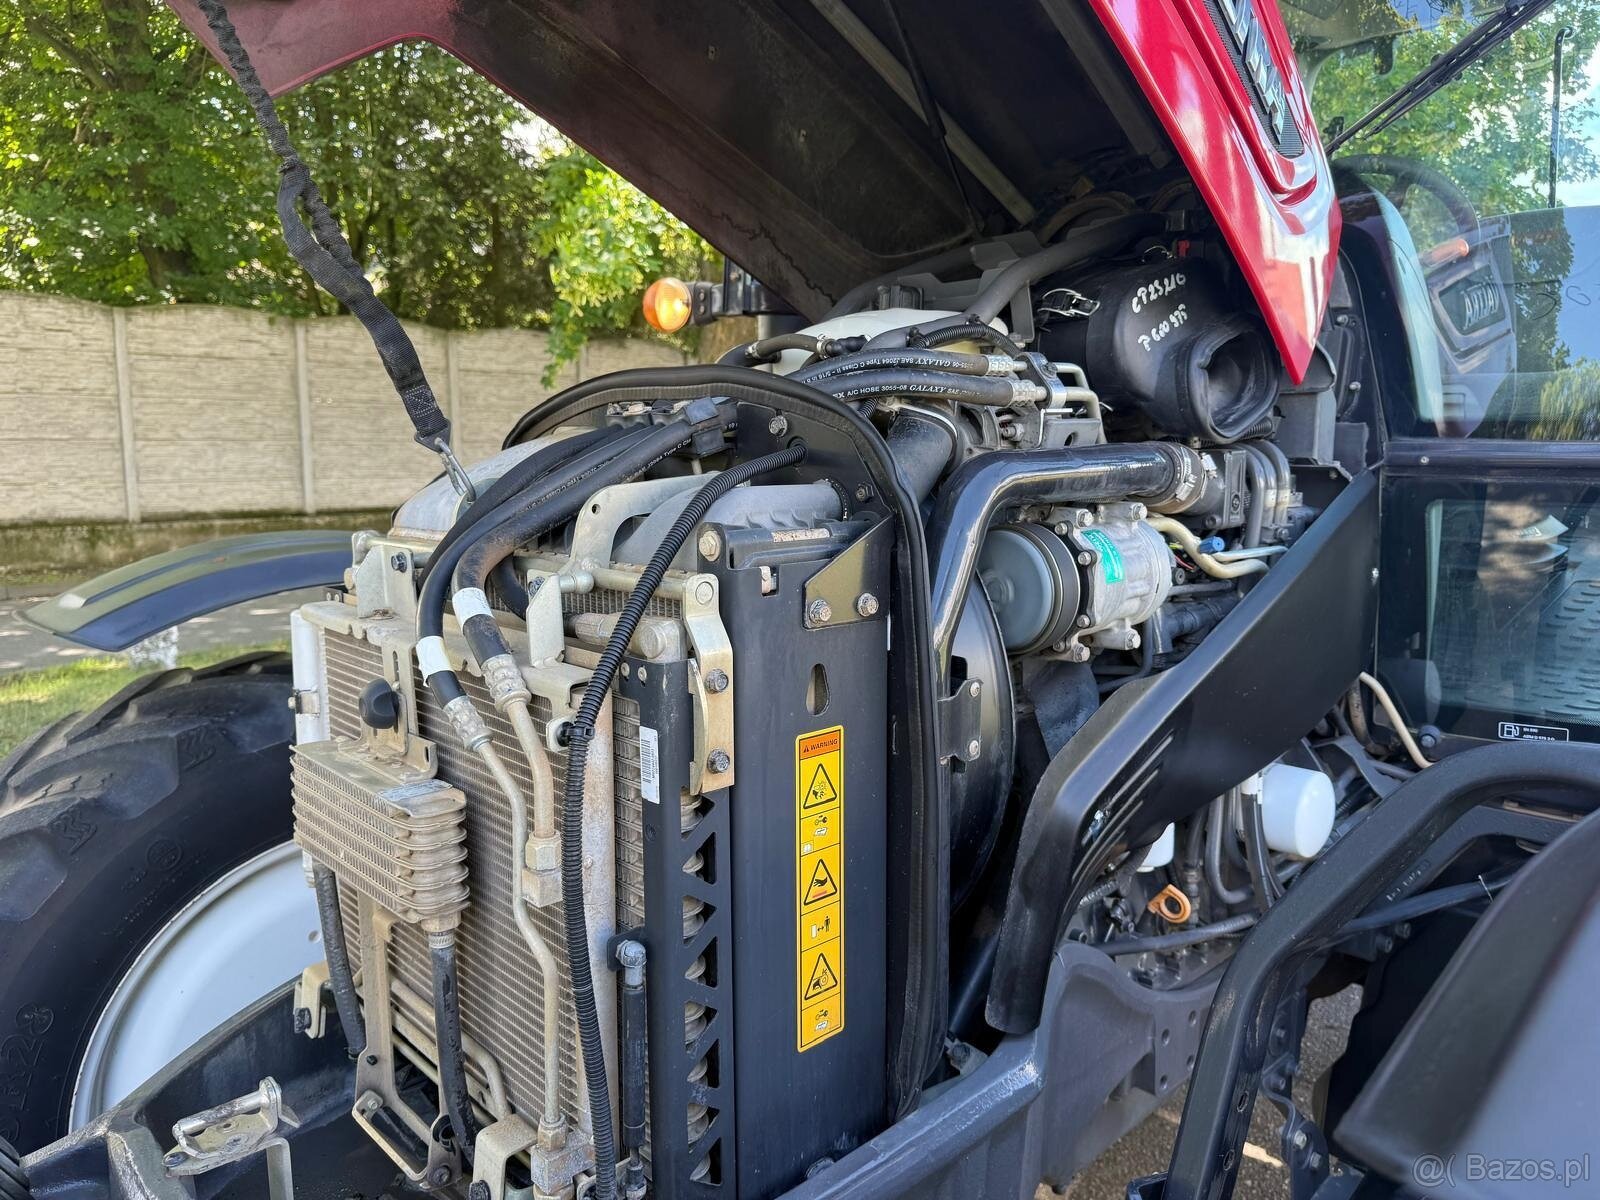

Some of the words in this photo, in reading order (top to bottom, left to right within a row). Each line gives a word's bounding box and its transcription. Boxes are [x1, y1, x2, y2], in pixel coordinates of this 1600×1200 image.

[842, 363, 858, 371] Class
[915, 358, 951, 367] GALAXY
[847, 389, 859, 397] A/C
[860, 386, 879, 394] HOSE
[909, 384, 946, 393] GALAXY
[811, 738, 838, 751] WARNING
